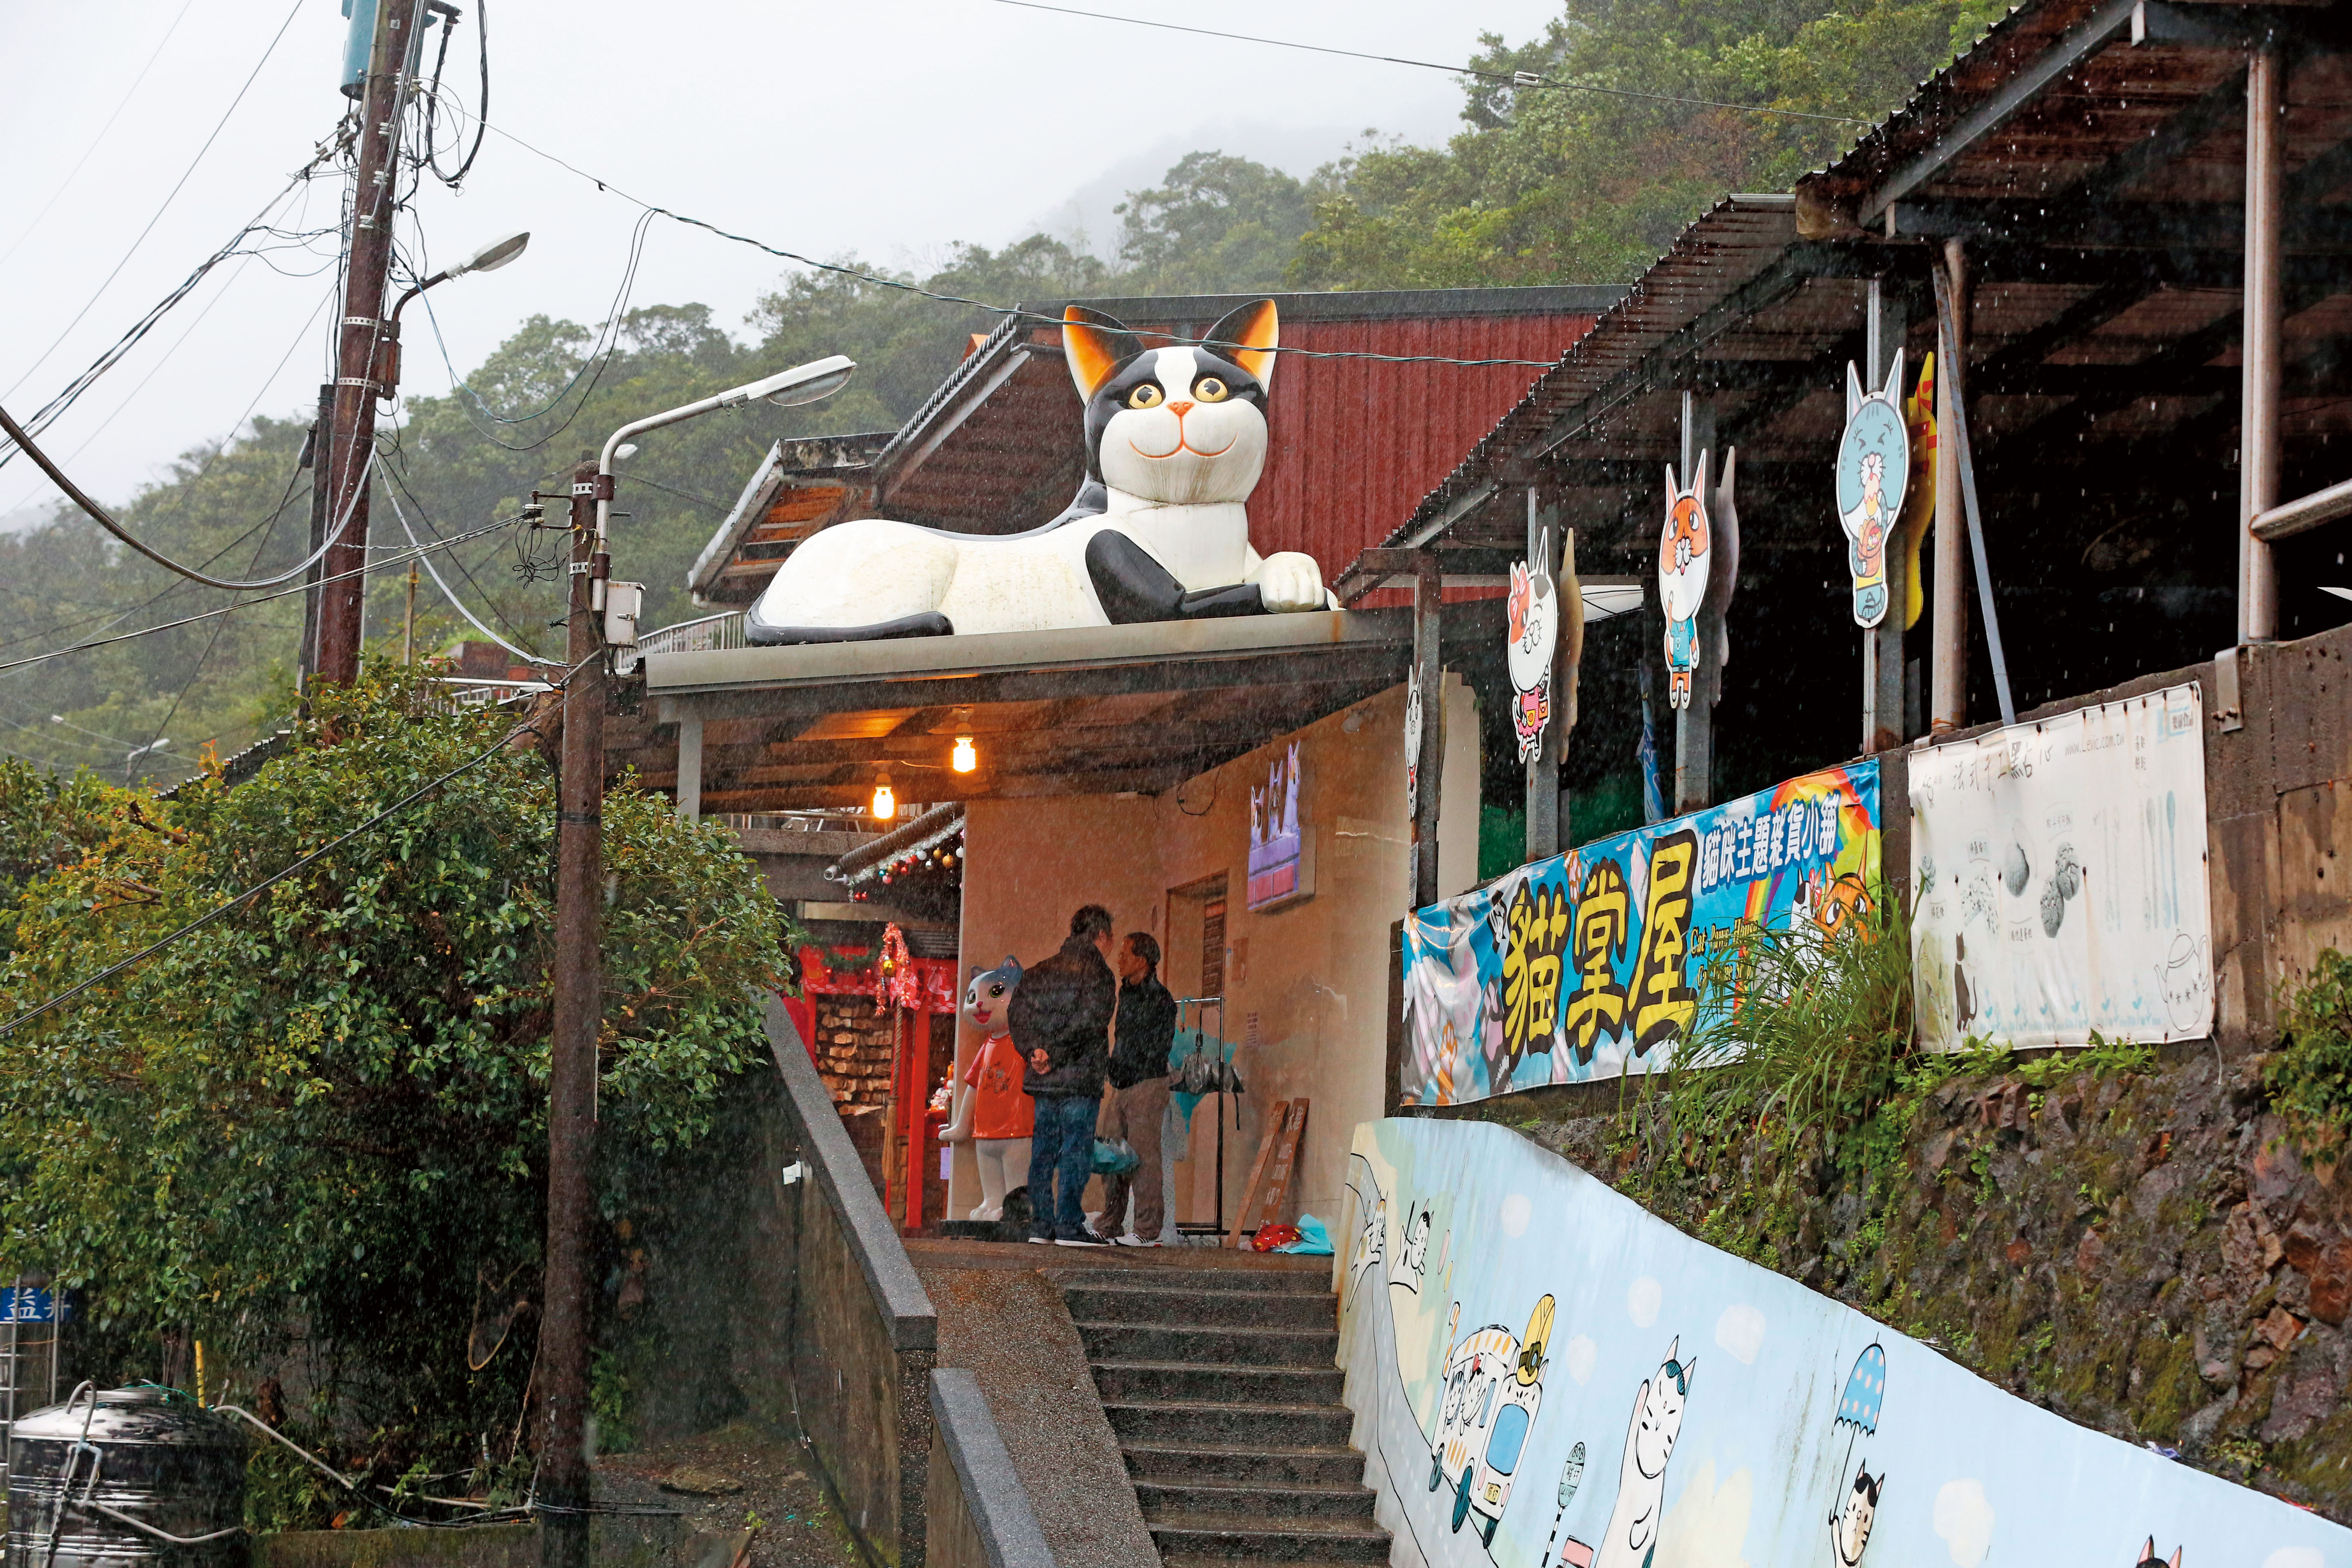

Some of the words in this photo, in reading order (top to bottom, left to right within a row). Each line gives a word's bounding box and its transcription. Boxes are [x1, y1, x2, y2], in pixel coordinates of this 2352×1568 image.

[1502, 842, 1695, 1056] 貓掌屋
[1691, 927, 1707, 955] Cat
[1711, 924, 1730, 951] Paws
[1697, 966, 1710, 987] Ca
[1572, 1446, 1584, 1460] 808
